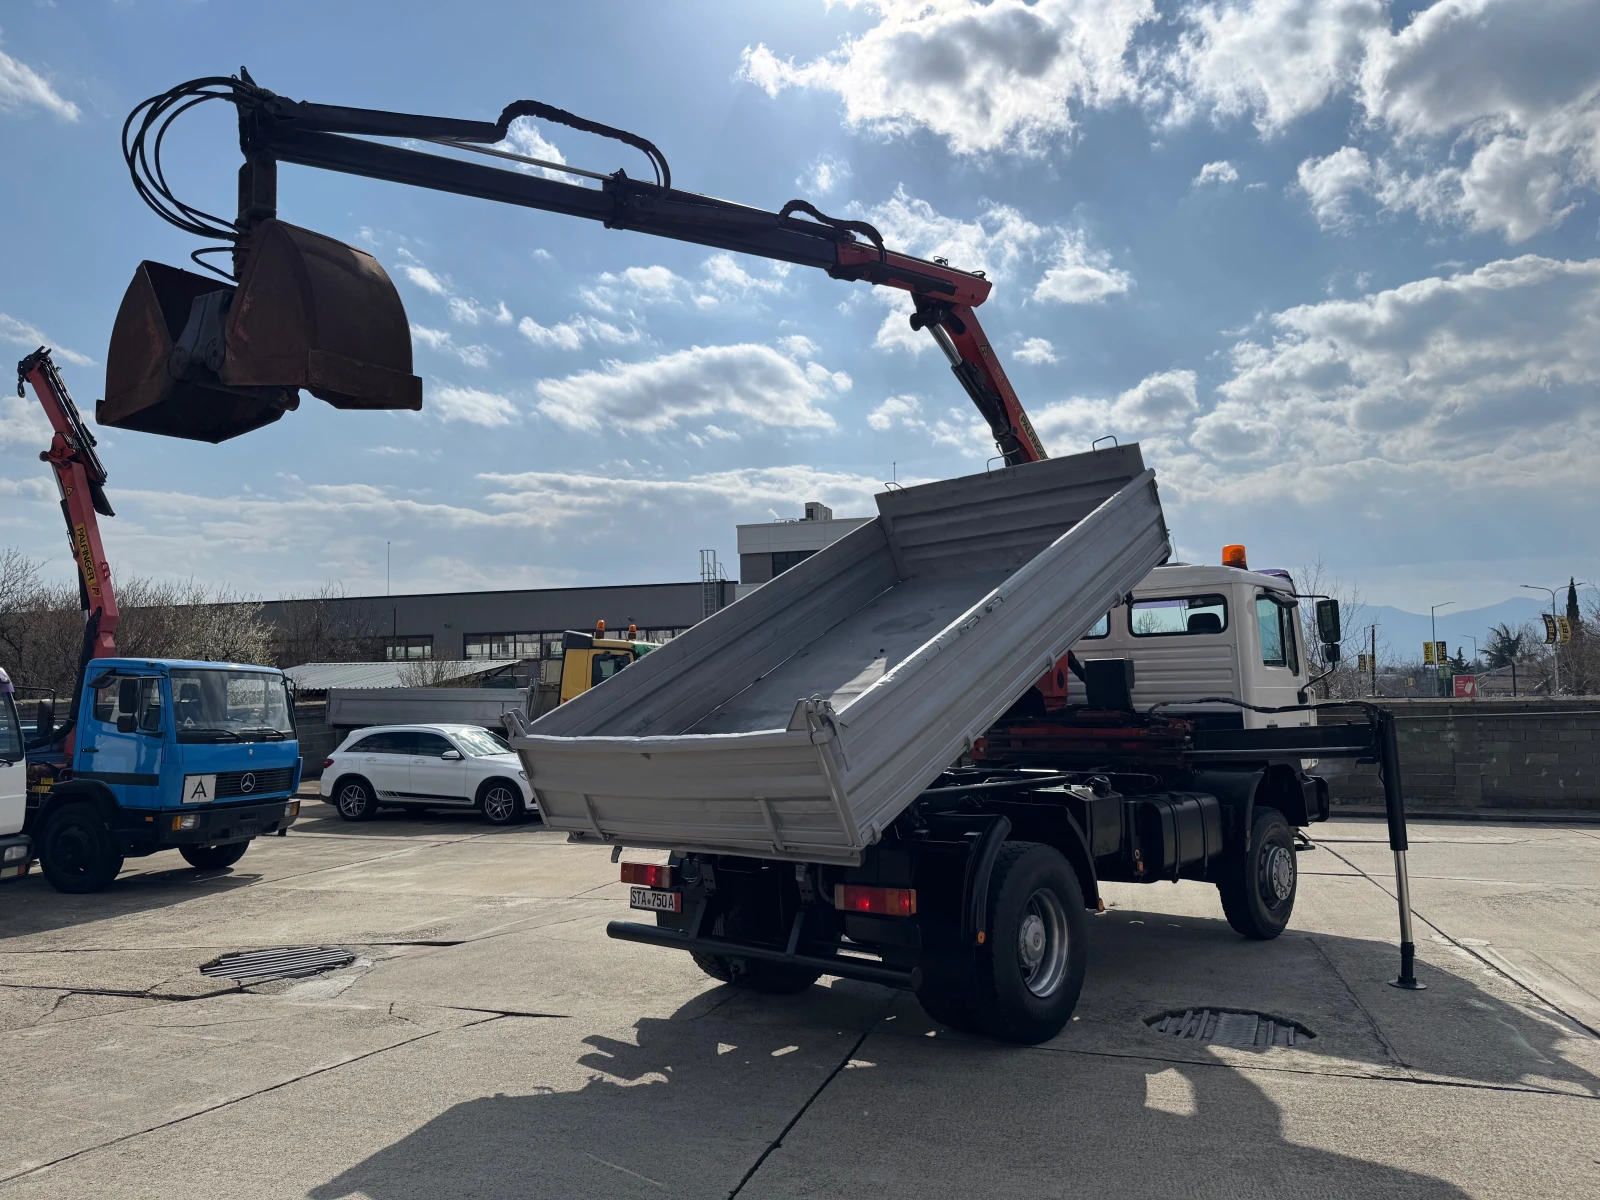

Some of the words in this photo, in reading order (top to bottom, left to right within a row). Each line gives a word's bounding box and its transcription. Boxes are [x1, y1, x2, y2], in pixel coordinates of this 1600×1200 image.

[76, 526, 95, 582] PALFINGER
[191, 779, 207, 799] A
[632, 890, 647, 906] STA
